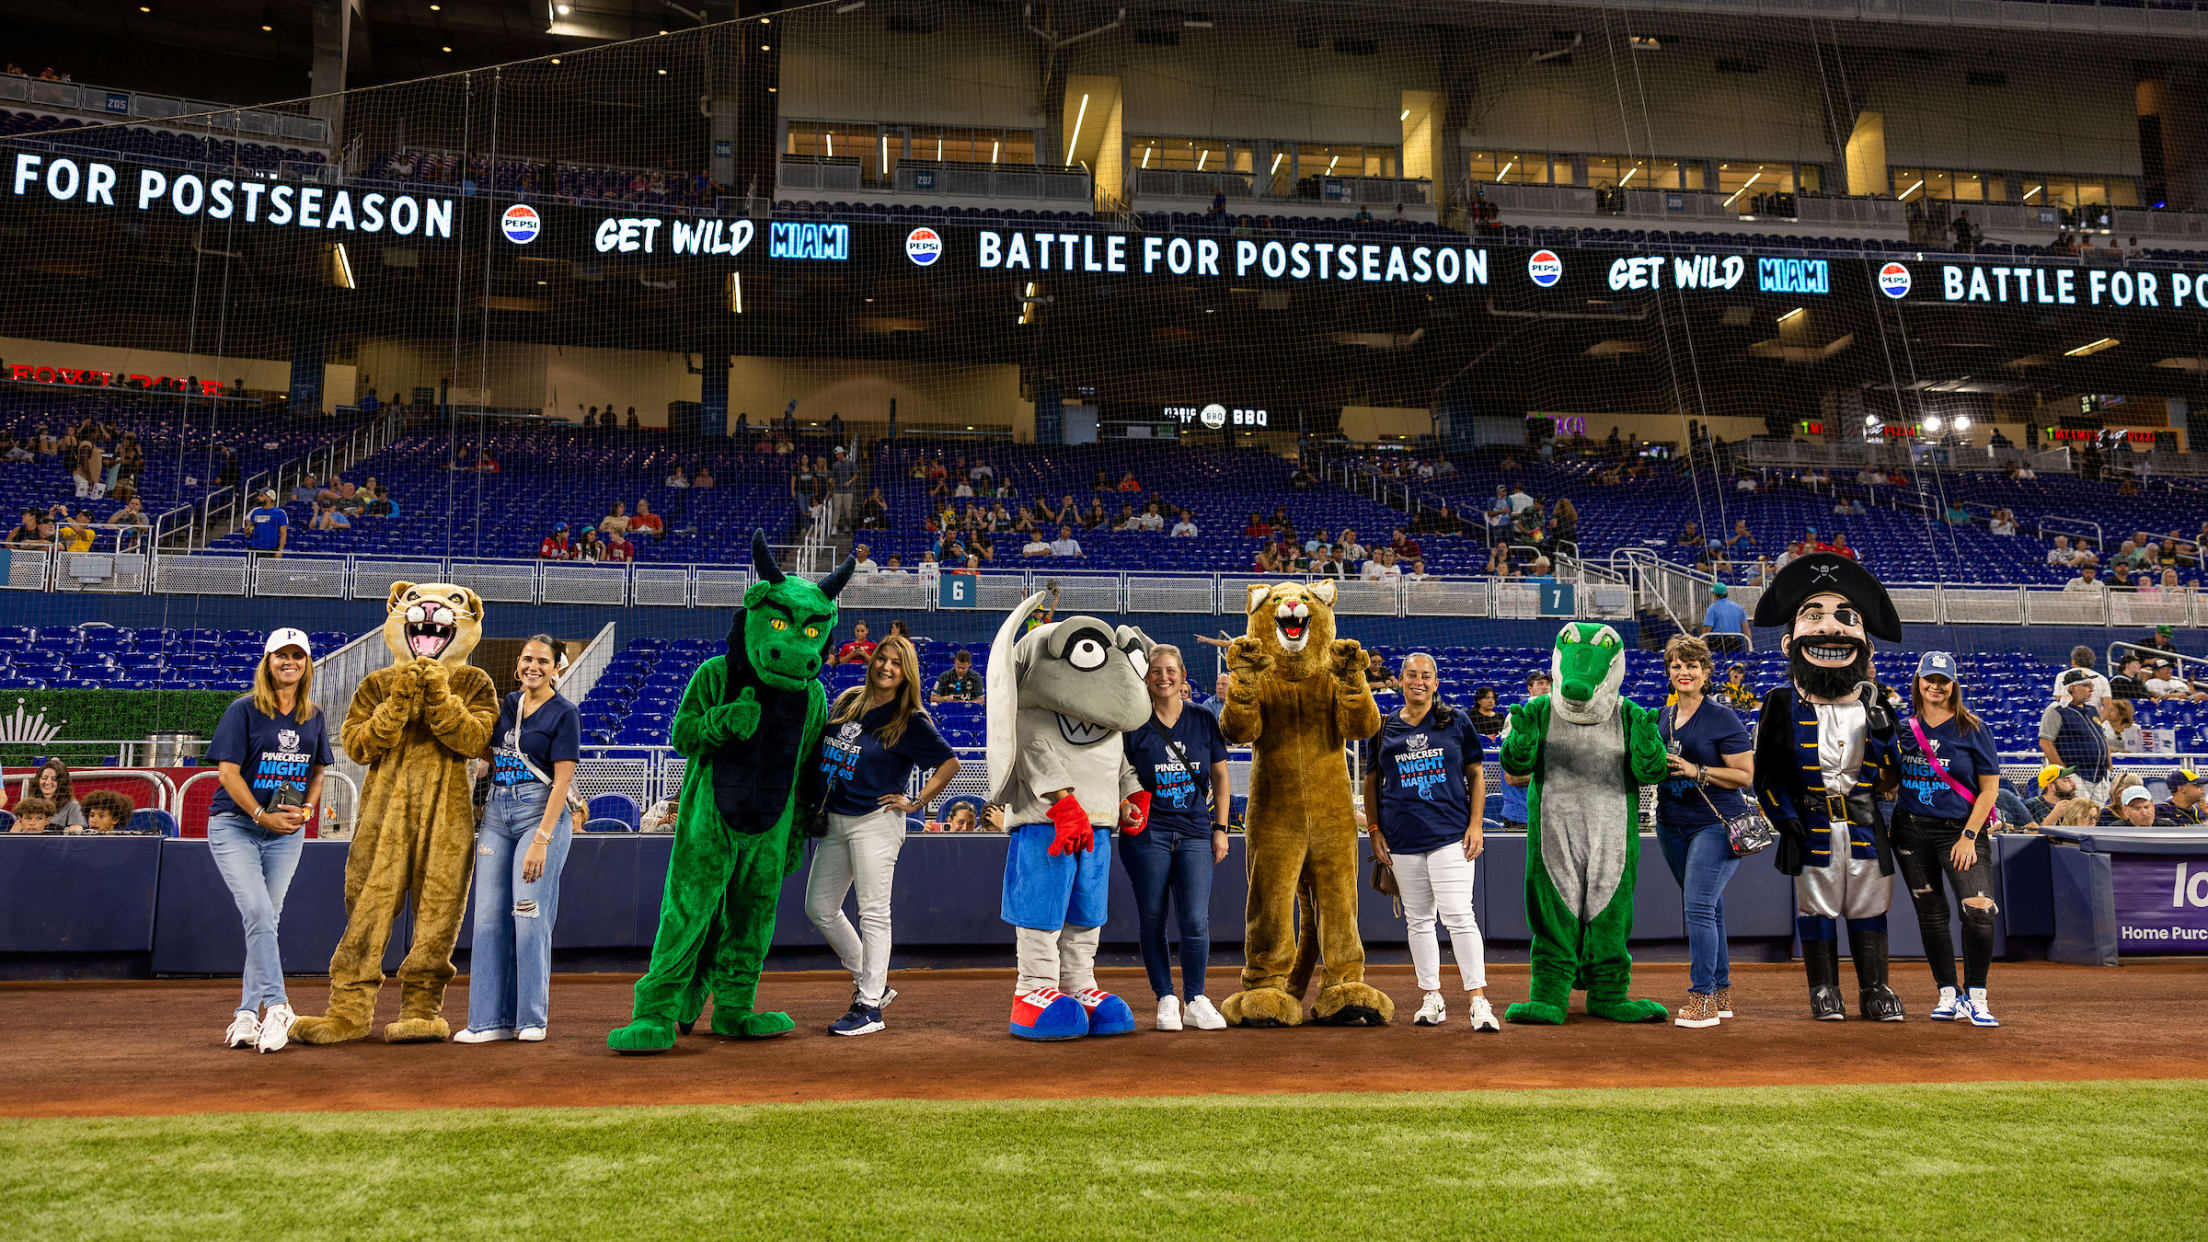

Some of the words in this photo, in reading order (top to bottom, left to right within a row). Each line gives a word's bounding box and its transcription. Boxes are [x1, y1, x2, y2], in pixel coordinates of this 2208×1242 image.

[107, 98, 127, 110] 205
[14, 153, 116, 206] FOR
[138, 169, 453, 238] POSTSEASON
[505, 219, 537, 229] PEPSI
[595, 218, 661, 254] GET
[673, 219, 754, 256] WILD
[770, 221, 849, 261] MIAMI
[909, 242, 939, 251] PEPSI
[980, 231, 1127, 273] BATTLE
[1144, 237, 1219, 275] FOR
[1237, 240, 1488, 285] POSTSEASON
[1532, 264, 1559, 272] PEPSI
[1608, 256, 1665, 291] GET
[1674, 255, 1745, 290] WILD
[1758, 257, 1829, 294] MIAMI
[1882, 276, 1908, 284] PEPSI
[1943, 265, 2075, 304] BATTLE
[2089, 270, 2159, 307] FOR
[1233, 409, 1267, 427] BBQ
[952, 581, 964, 601] 6
[1552, 589, 1561, 609] 7
[287, 630, 297, 640] P
[823, 735, 862, 755] PINECRST
[262, 751, 311, 763] PINECREST
[1395, 747, 1445, 763] PINECREST
[1902, 755, 1951, 767] PINECST
[257, 760, 310, 777] NIGHT
[1154, 761, 1201, 773] PINECRST
[1397, 756, 1445, 775] NIGHT
[252, 778, 308, 792] MARNS
[1401, 773, 1447, 788] MARLINS
[1902, 778, 1951, 790] MARLINS
[2121, 926, 2169, 940] Home
[2172, 926, 2208, 940] Purc
